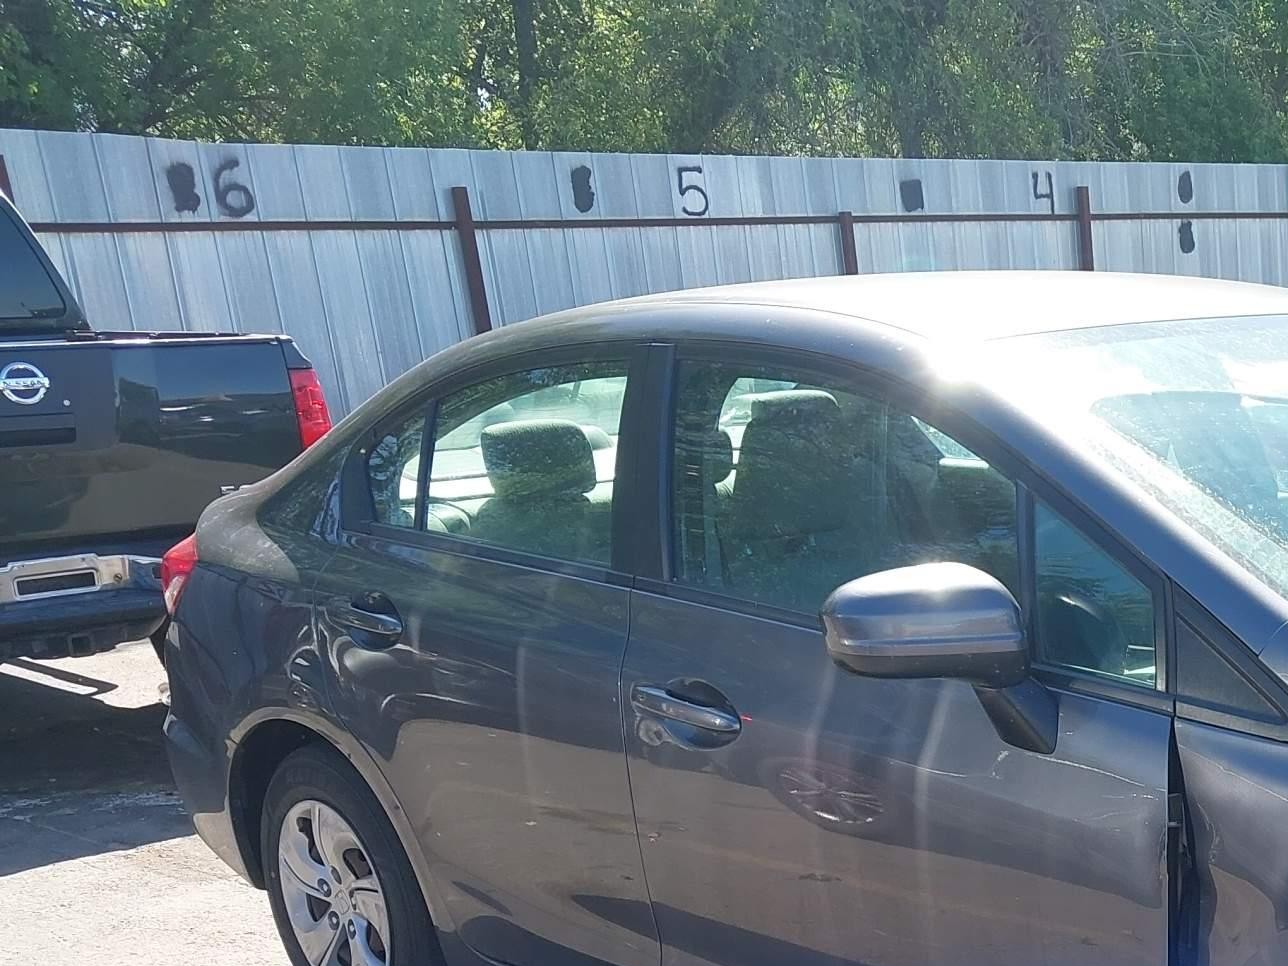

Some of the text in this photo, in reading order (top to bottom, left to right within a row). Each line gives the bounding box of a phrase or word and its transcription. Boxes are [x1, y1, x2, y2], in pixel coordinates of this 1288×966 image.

[213, 157, 255, 218] 6
[677, 166, 709, 216] 5
[1031, 171, 1055, 215] 4
